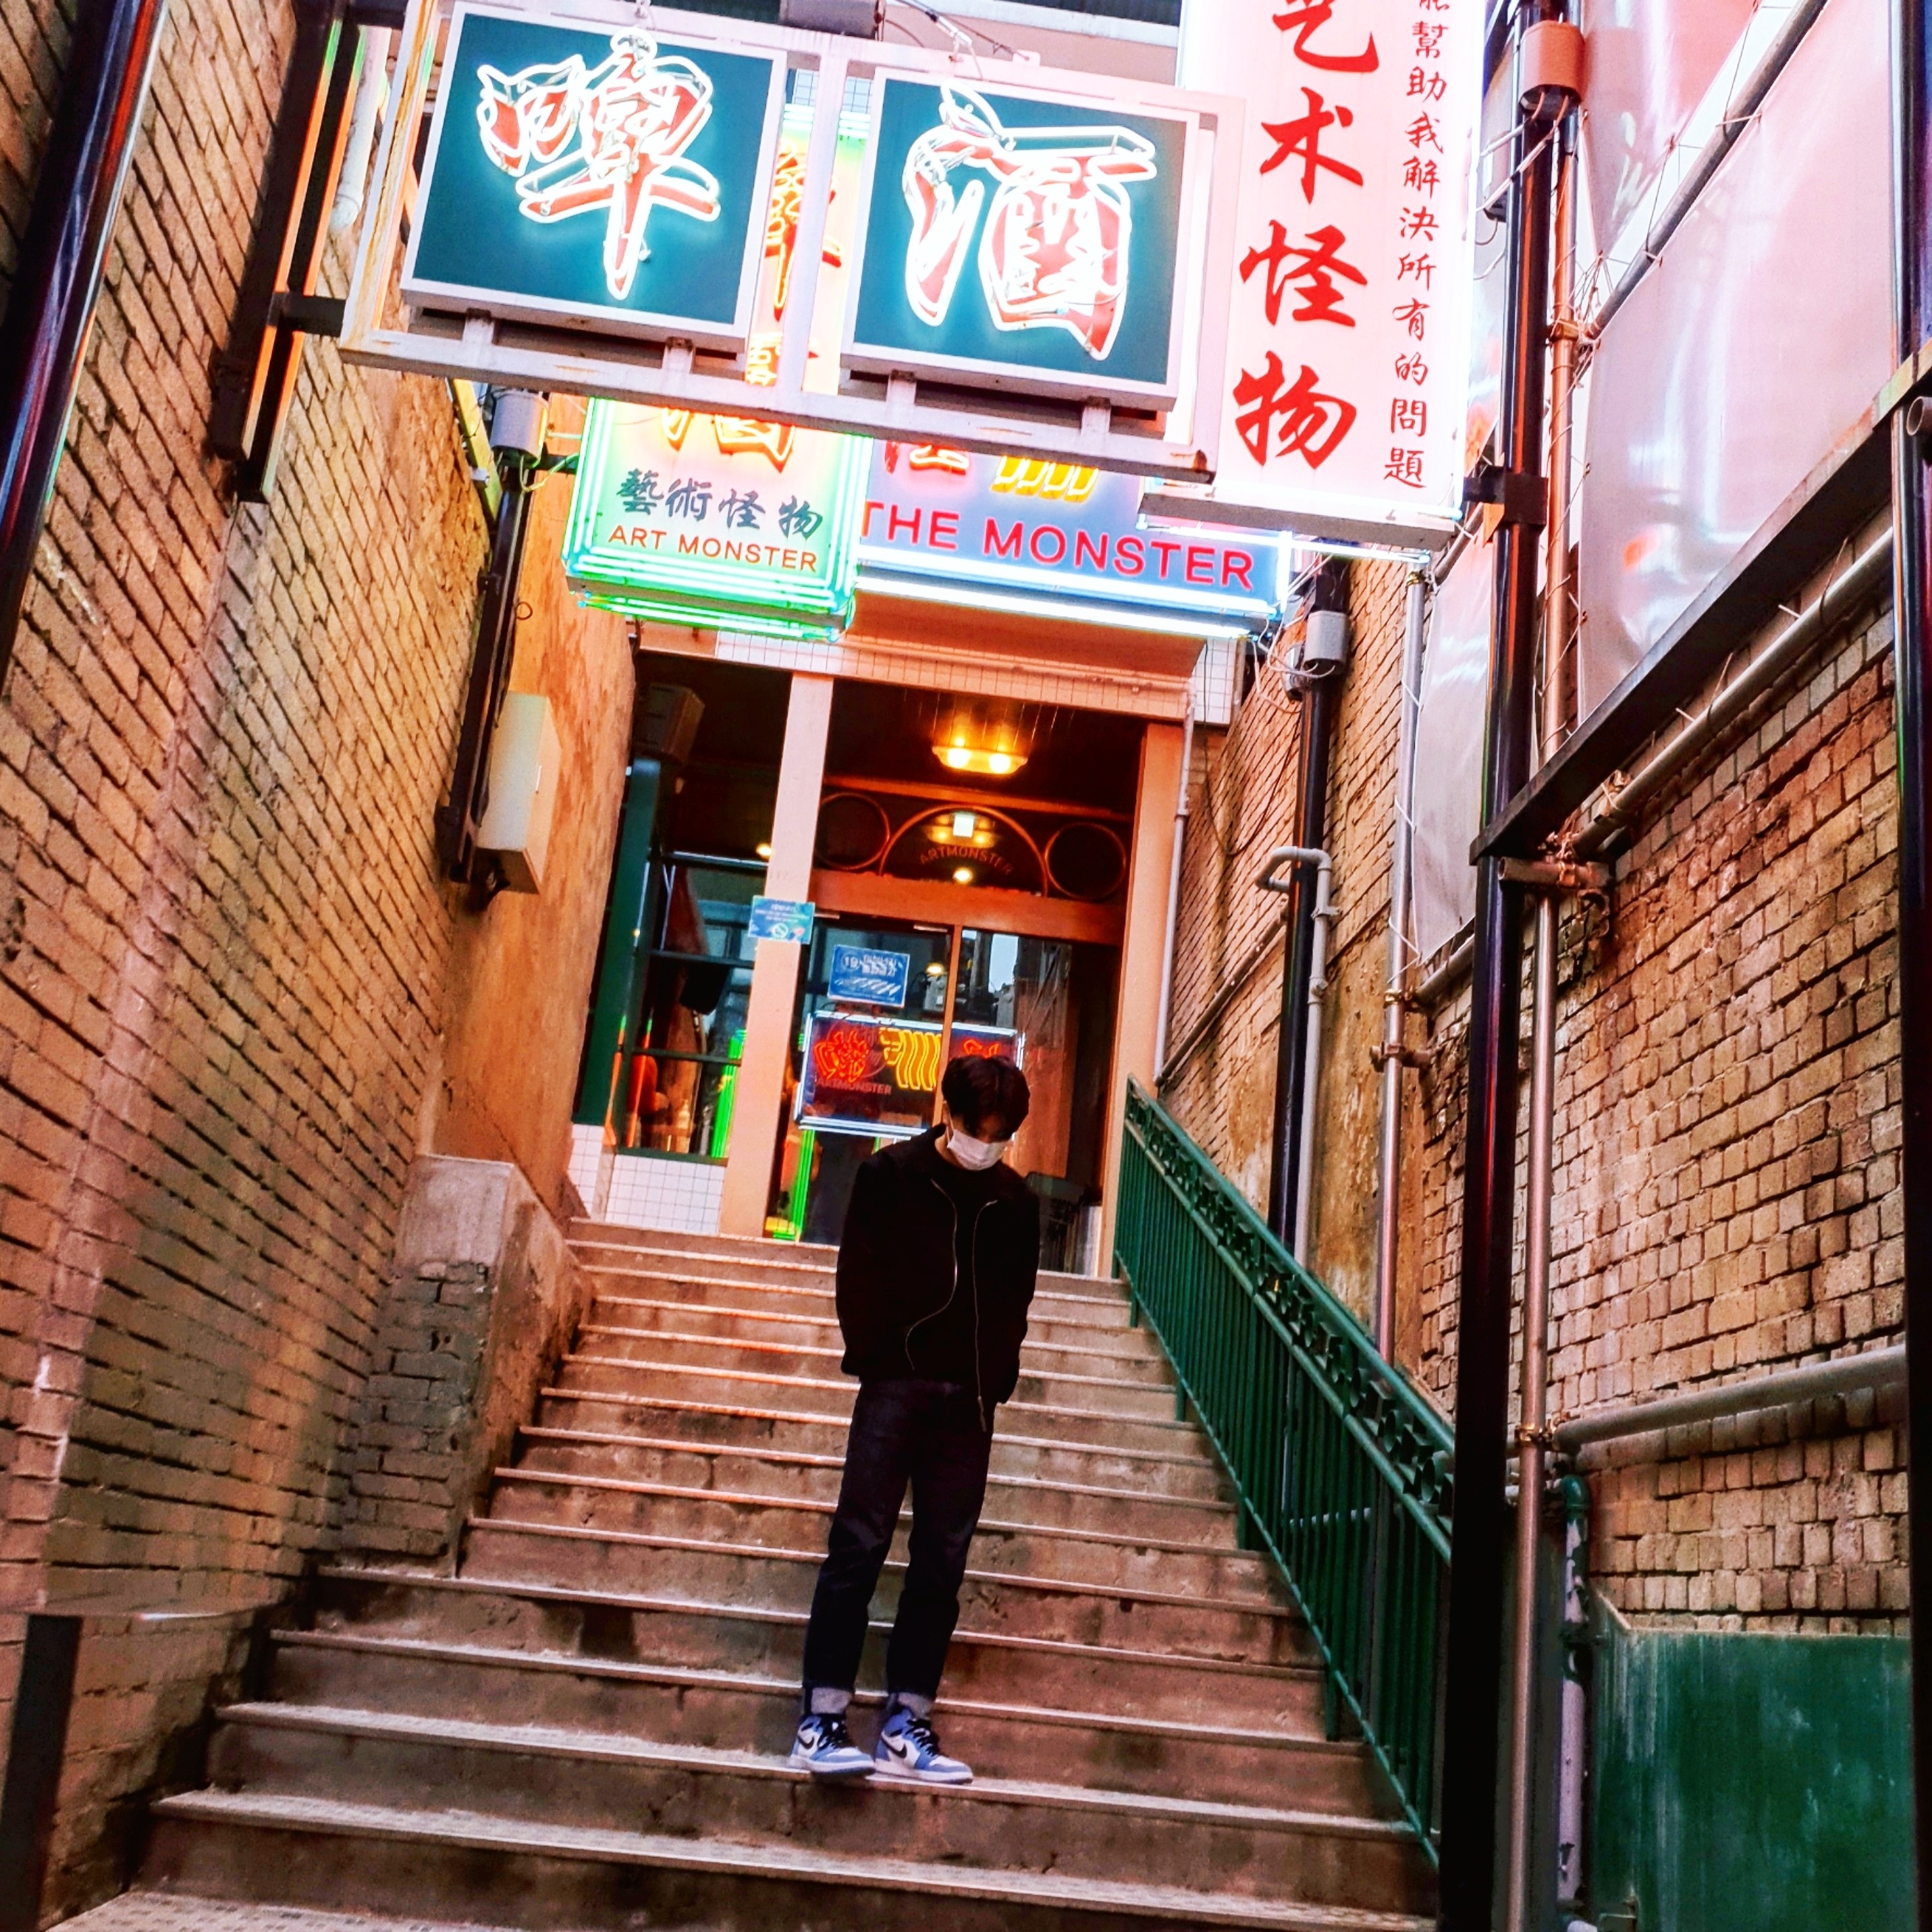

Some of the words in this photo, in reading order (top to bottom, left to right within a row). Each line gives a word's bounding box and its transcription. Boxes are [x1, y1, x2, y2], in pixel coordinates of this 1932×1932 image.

[616, 468, 823, 541] 藝術怪物
[608, 525, 667, 549] ART
[678, 534, 817, 572] MONSTER
[861, 501, 959, 550] THE
[982, 517, 1253, 591] MONSTER
[920, 846, 1013, 875] ARTMONSTER
